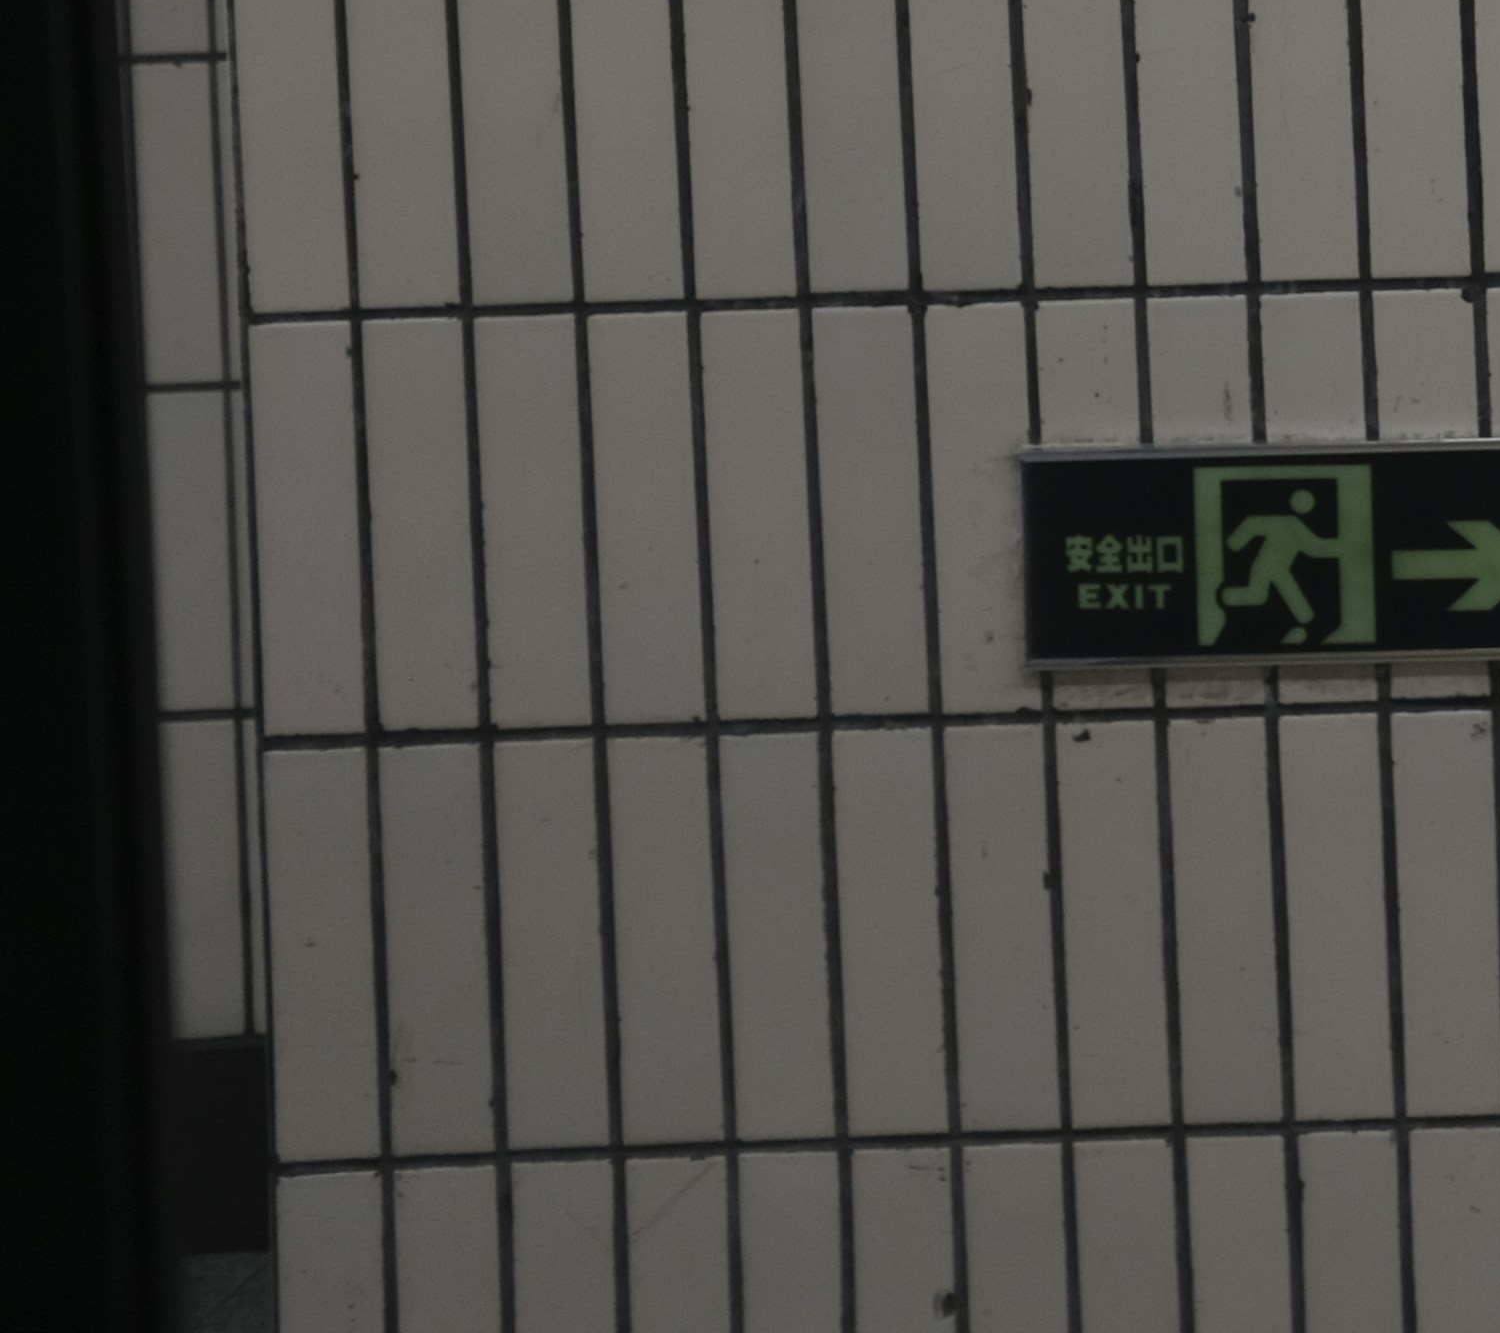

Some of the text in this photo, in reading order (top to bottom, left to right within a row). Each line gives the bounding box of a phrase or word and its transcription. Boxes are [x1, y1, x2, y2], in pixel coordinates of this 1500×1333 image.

[1065, 534, 1185, 574] 安全出口
[1077, 584, 1173, 611] EXIT
